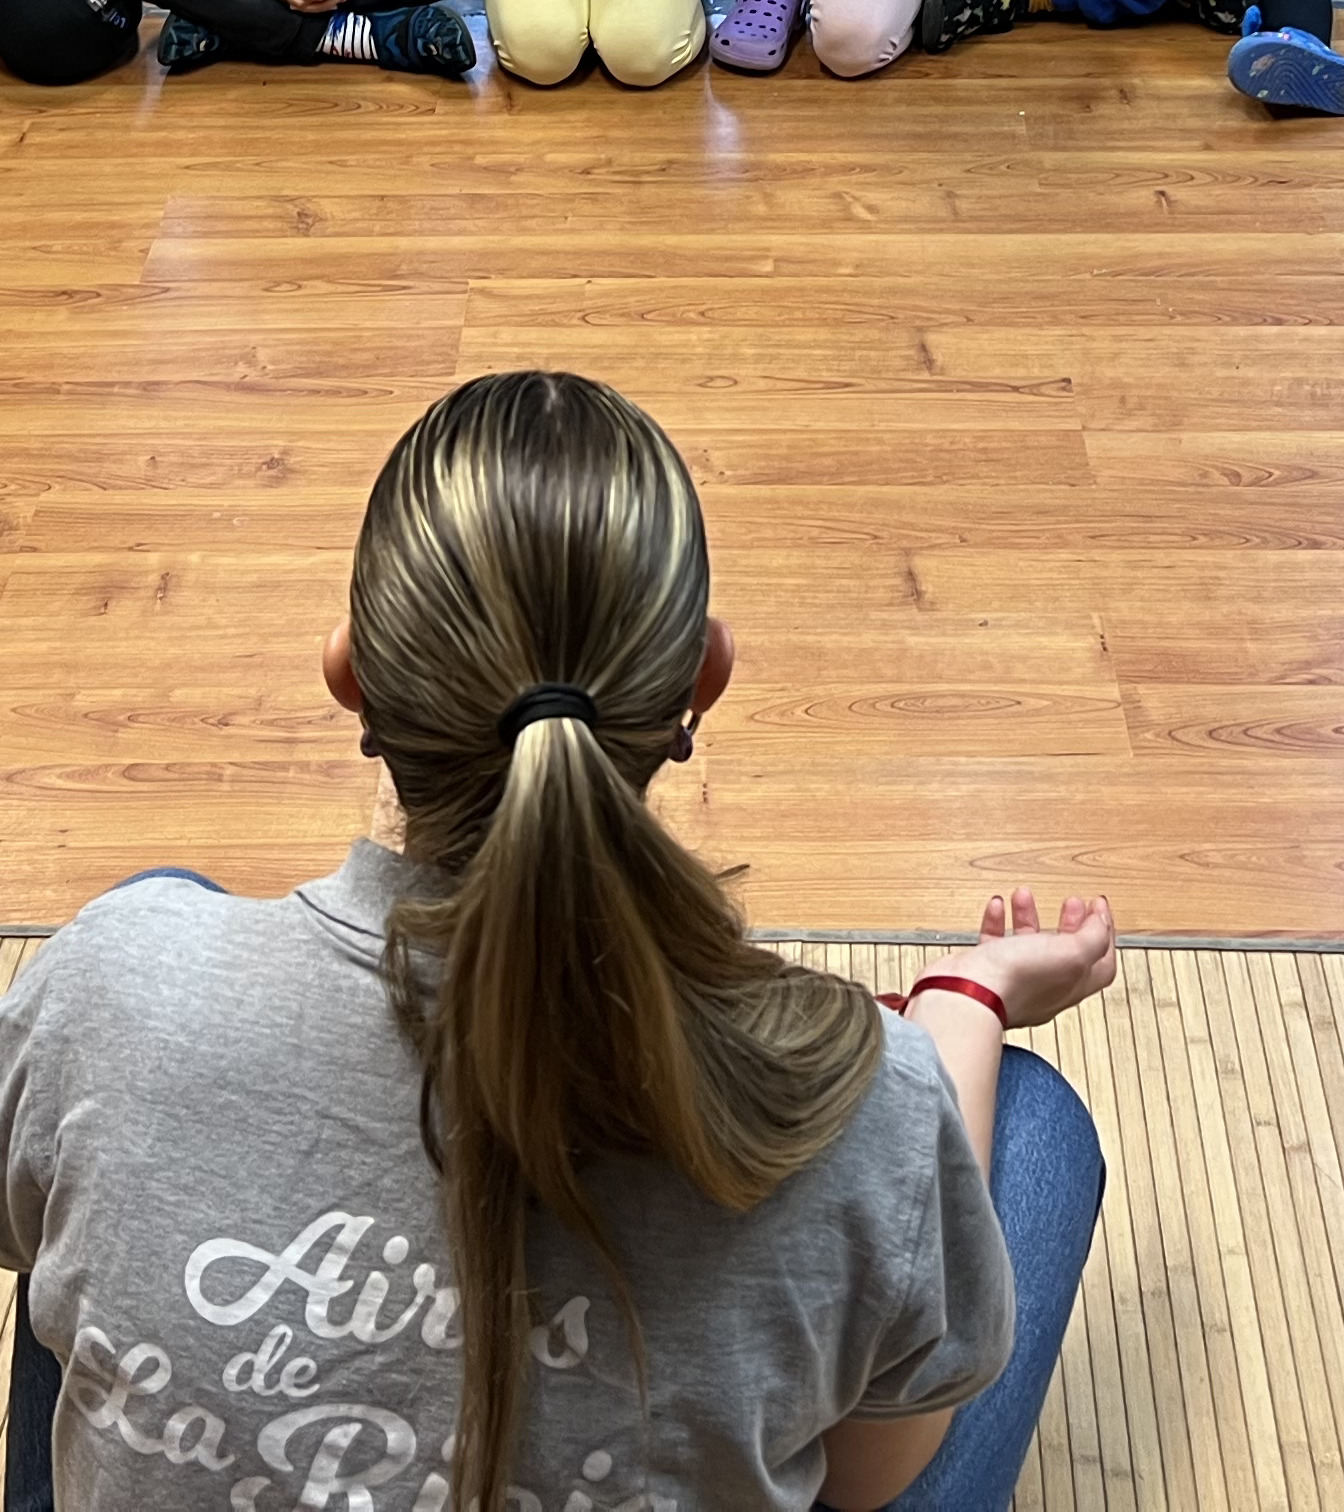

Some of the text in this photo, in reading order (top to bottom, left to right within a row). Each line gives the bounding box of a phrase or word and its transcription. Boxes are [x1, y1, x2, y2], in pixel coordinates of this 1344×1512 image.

[184, 1210, 591, 1370] Airs
[223, 1323, 321, 1398] de
[66, 1325, 236, 1472] La
